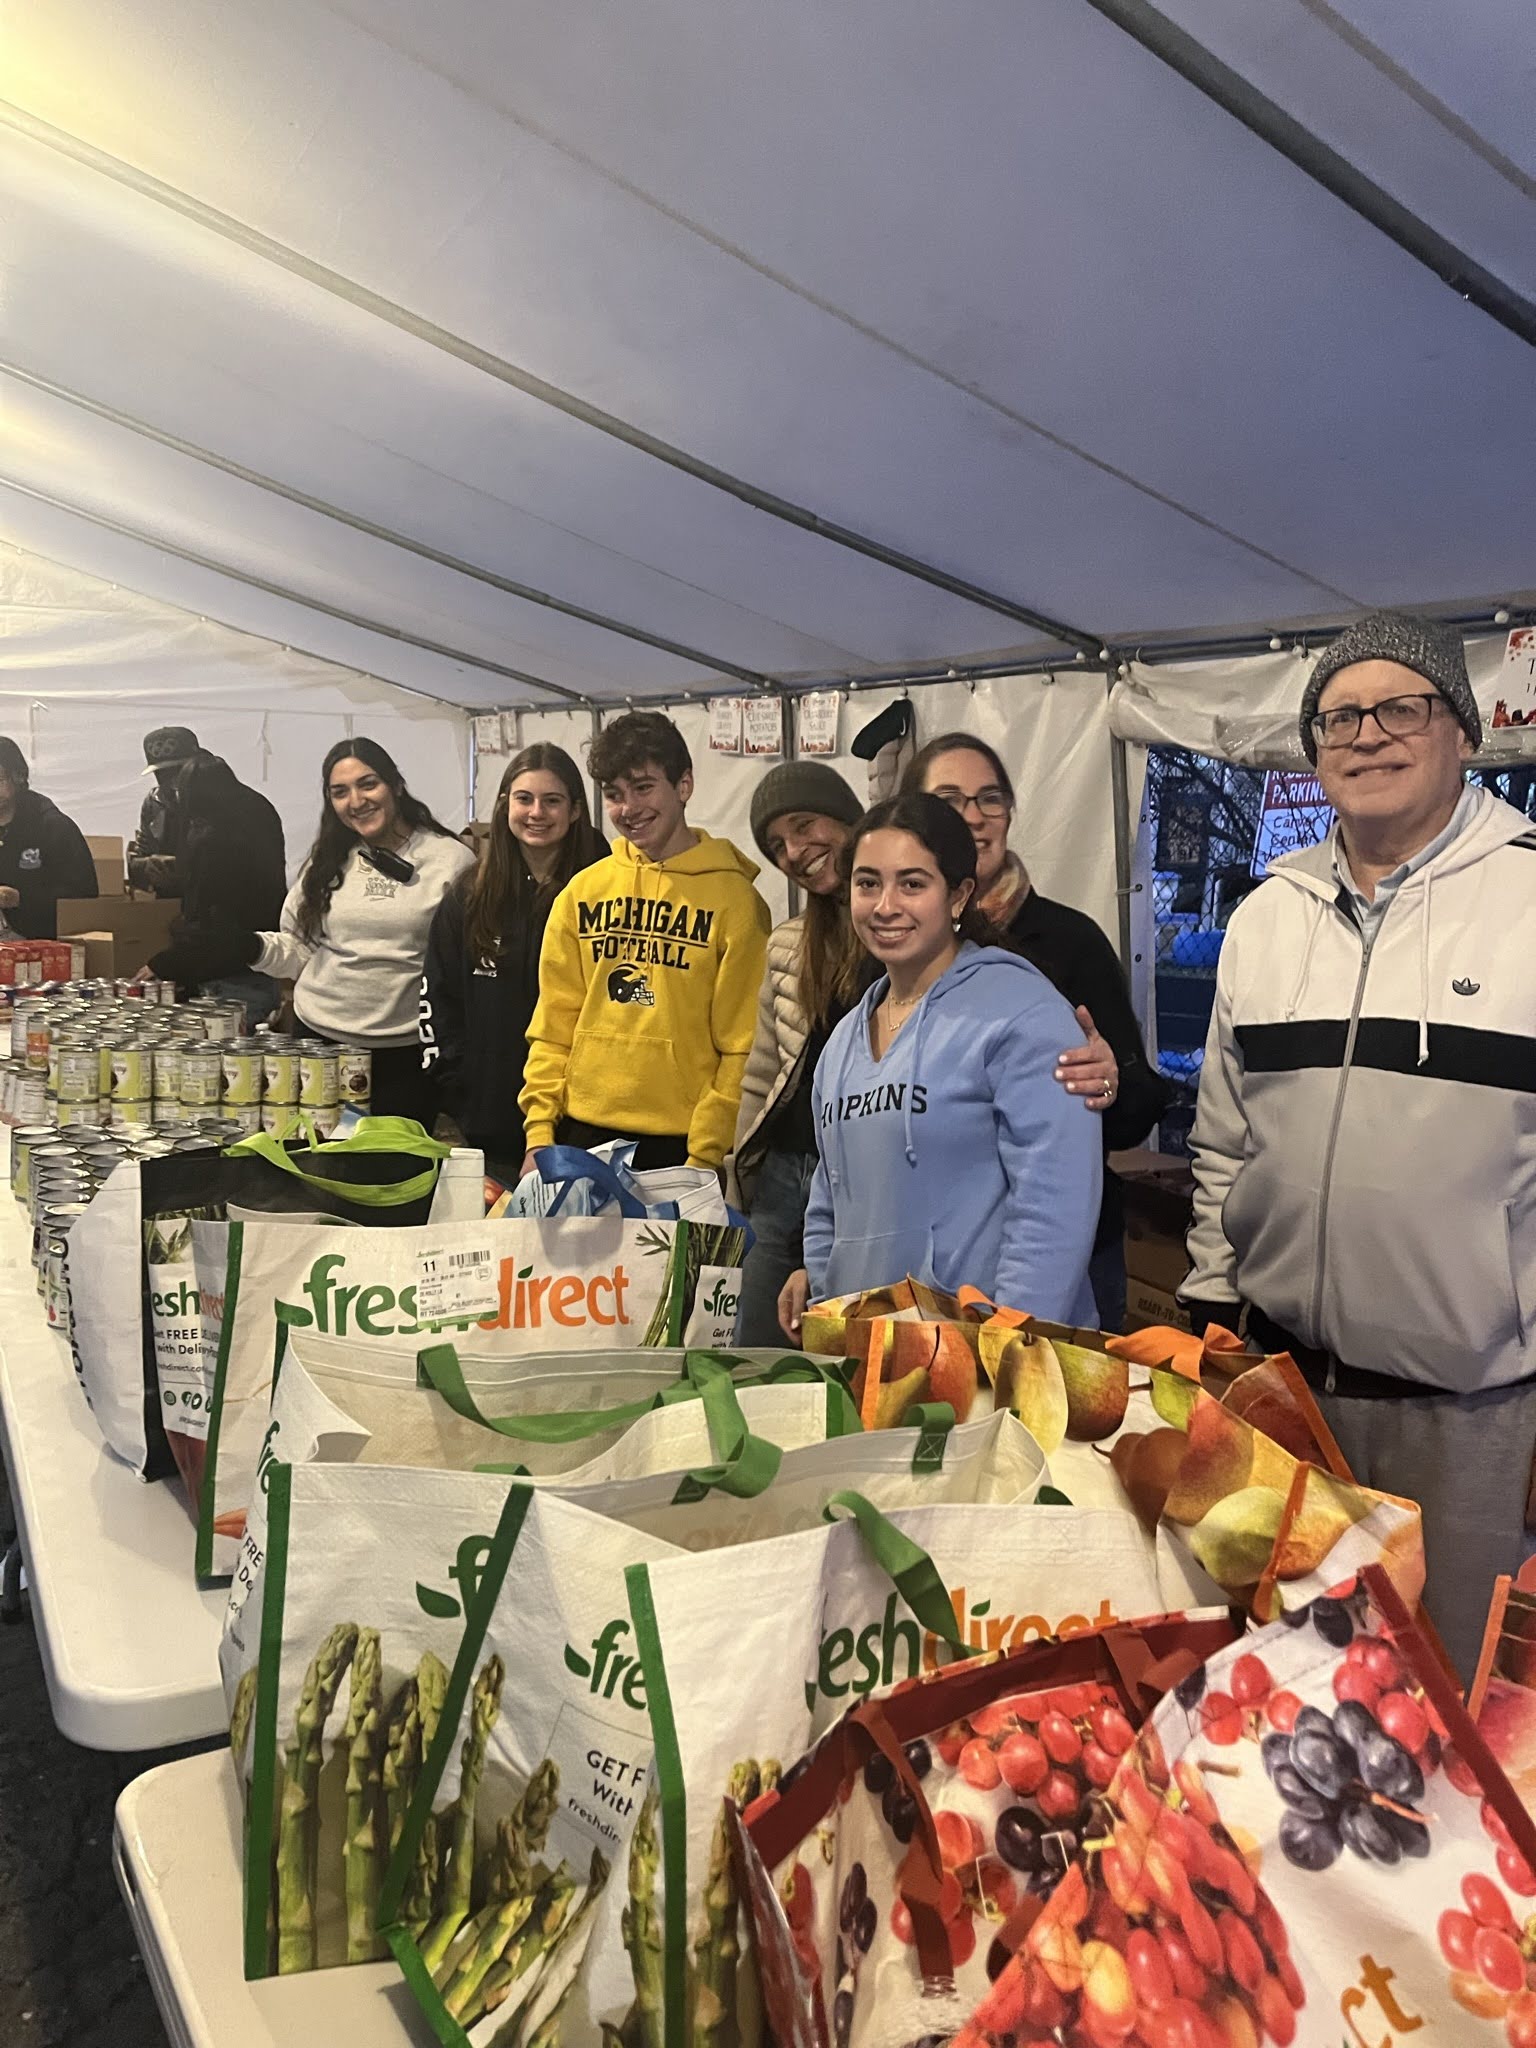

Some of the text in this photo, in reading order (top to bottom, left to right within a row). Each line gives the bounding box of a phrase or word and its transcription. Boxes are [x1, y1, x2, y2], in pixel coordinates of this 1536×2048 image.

[578, 896, 714, 943] MICHIGAN
[592, 935, 690, 970] FOTBALL
[423, 1260, 436, 1273] 11
[166, 1328, 199, 1341] FREE
[586, 1750, 630, 1782] GET
